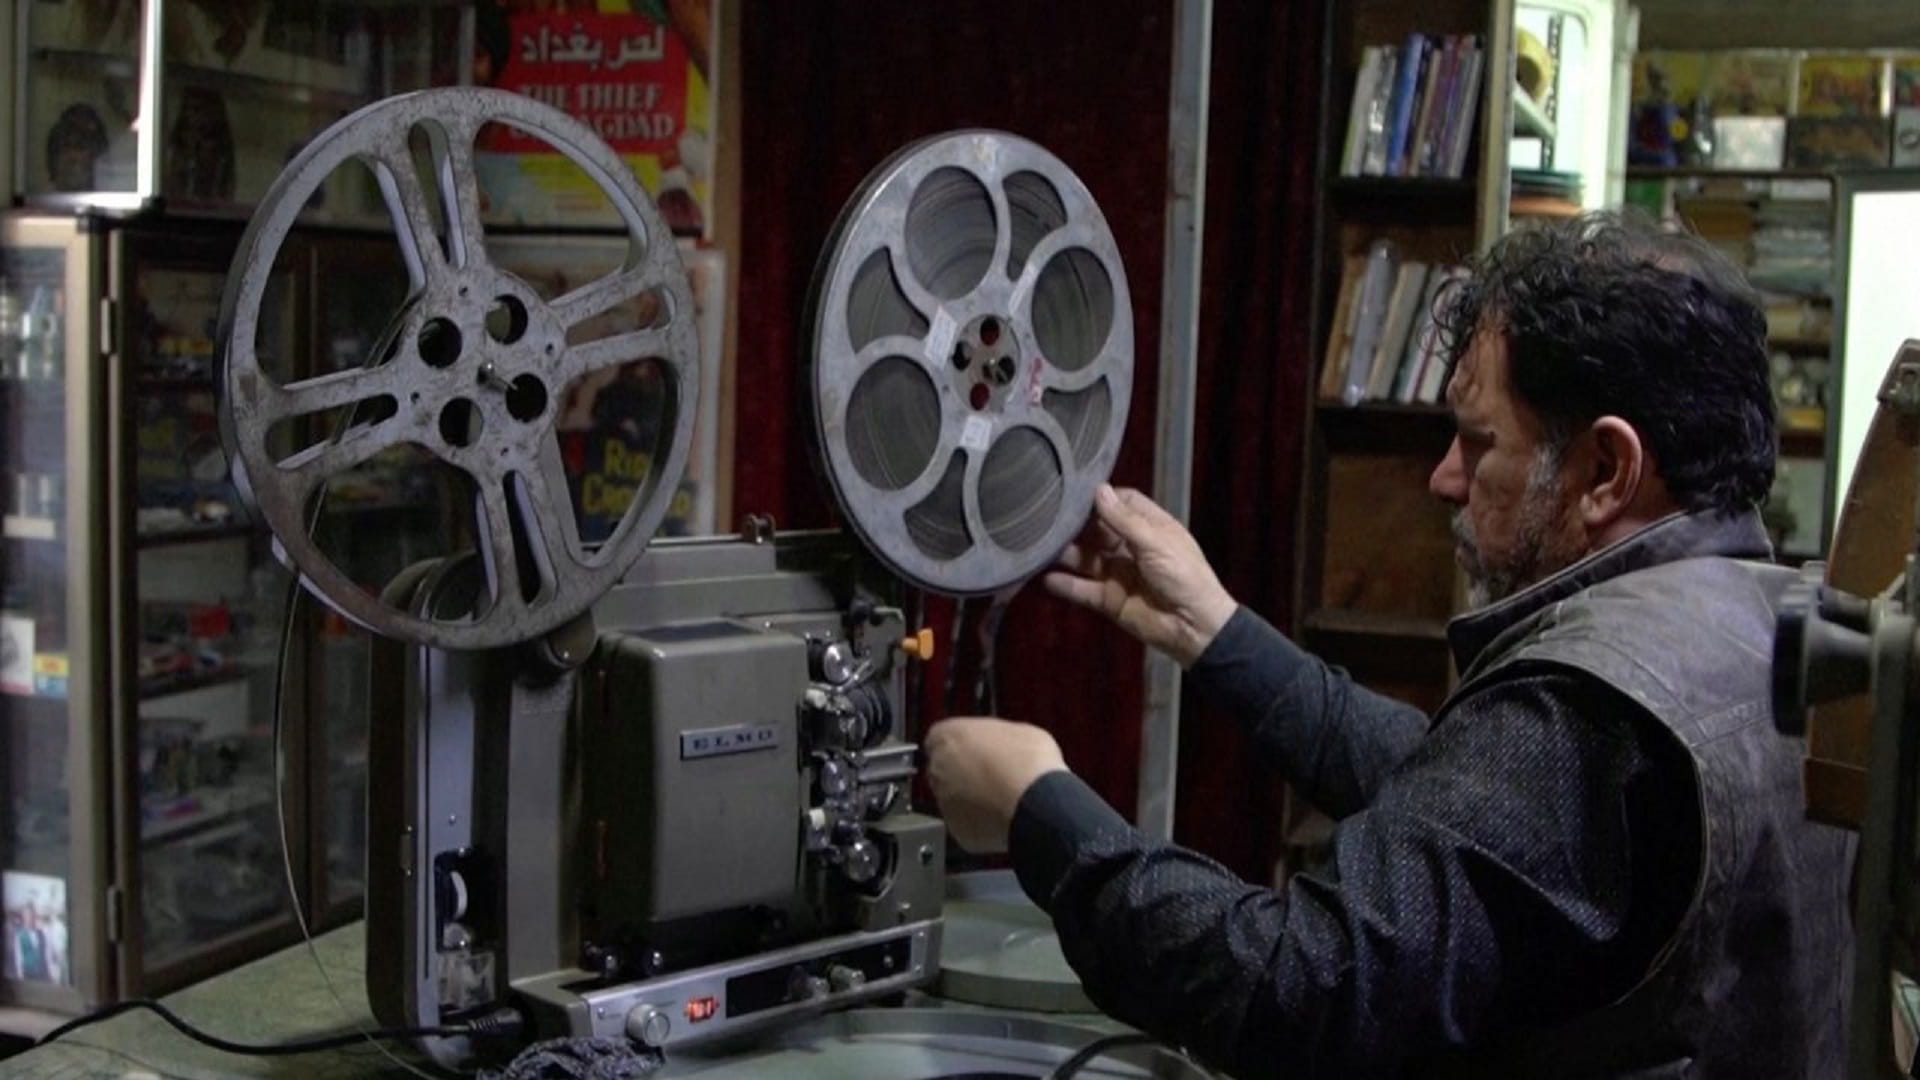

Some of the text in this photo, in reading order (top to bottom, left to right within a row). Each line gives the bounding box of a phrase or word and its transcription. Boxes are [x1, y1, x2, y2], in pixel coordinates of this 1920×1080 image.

[521, 21, 604, 71] بغداد
[576, 82, 664, 112] THIEF
[576, 112, 675, 140] AGDAD
[693, 729, 773, 750] ELMO
